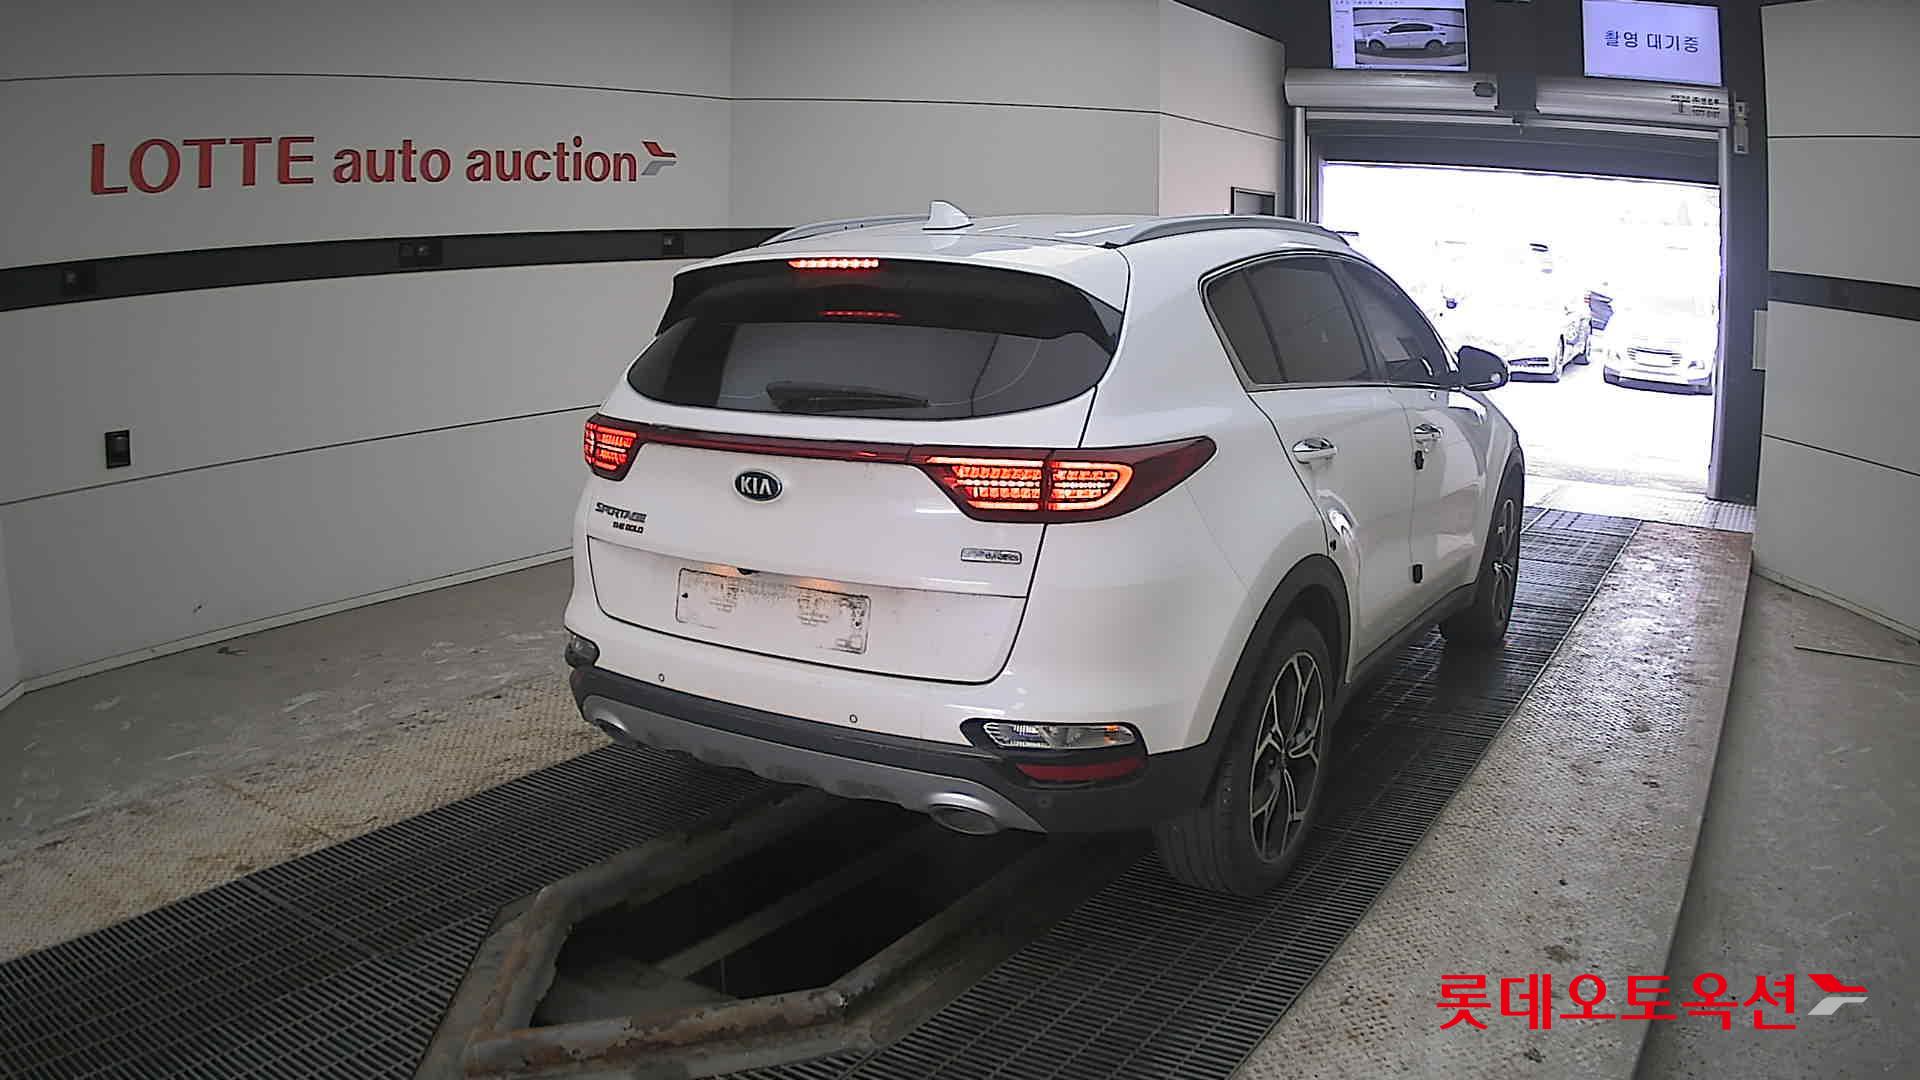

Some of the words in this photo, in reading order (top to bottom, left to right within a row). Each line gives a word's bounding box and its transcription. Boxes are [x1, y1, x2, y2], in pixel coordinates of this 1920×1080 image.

[1604, 30, 1638, 48] 촬영
[1647, 33, 1698, 53] 대기중
[91, 135, 315, 195] LOTTE
[333, 138, 451, 184] auto
[465, 136, 637, 184] auction
[741, 475, 773, 496] KIA
